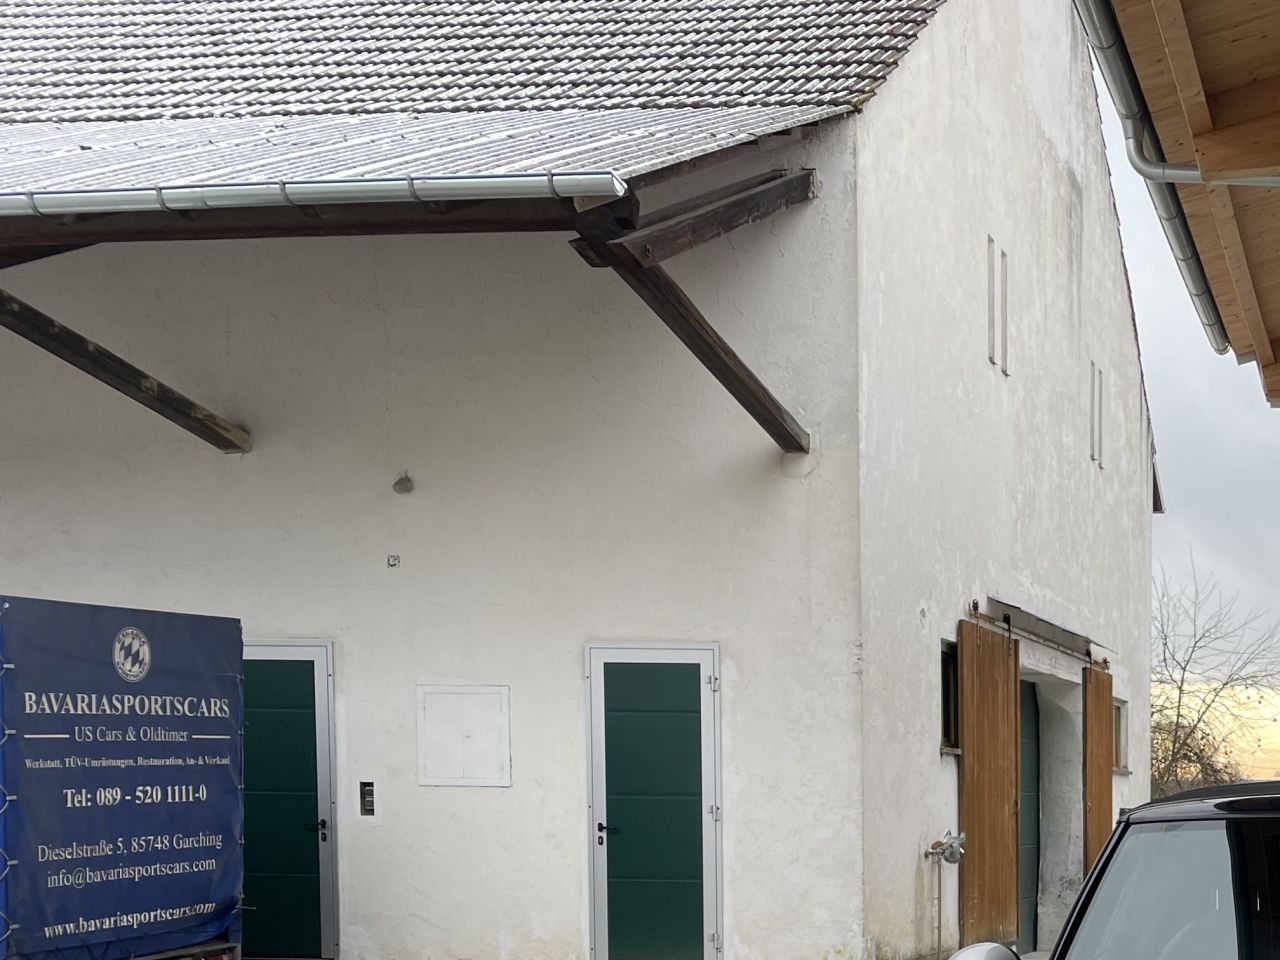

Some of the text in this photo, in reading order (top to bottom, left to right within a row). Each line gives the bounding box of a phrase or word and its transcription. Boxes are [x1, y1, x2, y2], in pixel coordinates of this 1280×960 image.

[24, 691, 230, 718] BAVARIASPORTSCARS
[74, 726, 188, 742] US Cars & Oldtimer
[62, 788, 92, 808] Tel:
[96, 787, 121, 806] 089
[135, 785, 161, 804] 520
[166, 784, 207, 803] 1111-0
[37, 839, 113, 862] Dieselstraße
[130, 834, 170, 853] 85748
[172, 831, 223, 850] Garching
[47, 858, 216, 888] info@bavariasportscars.com
[43, 901, 216, 939] www.bavariasportscars.com
